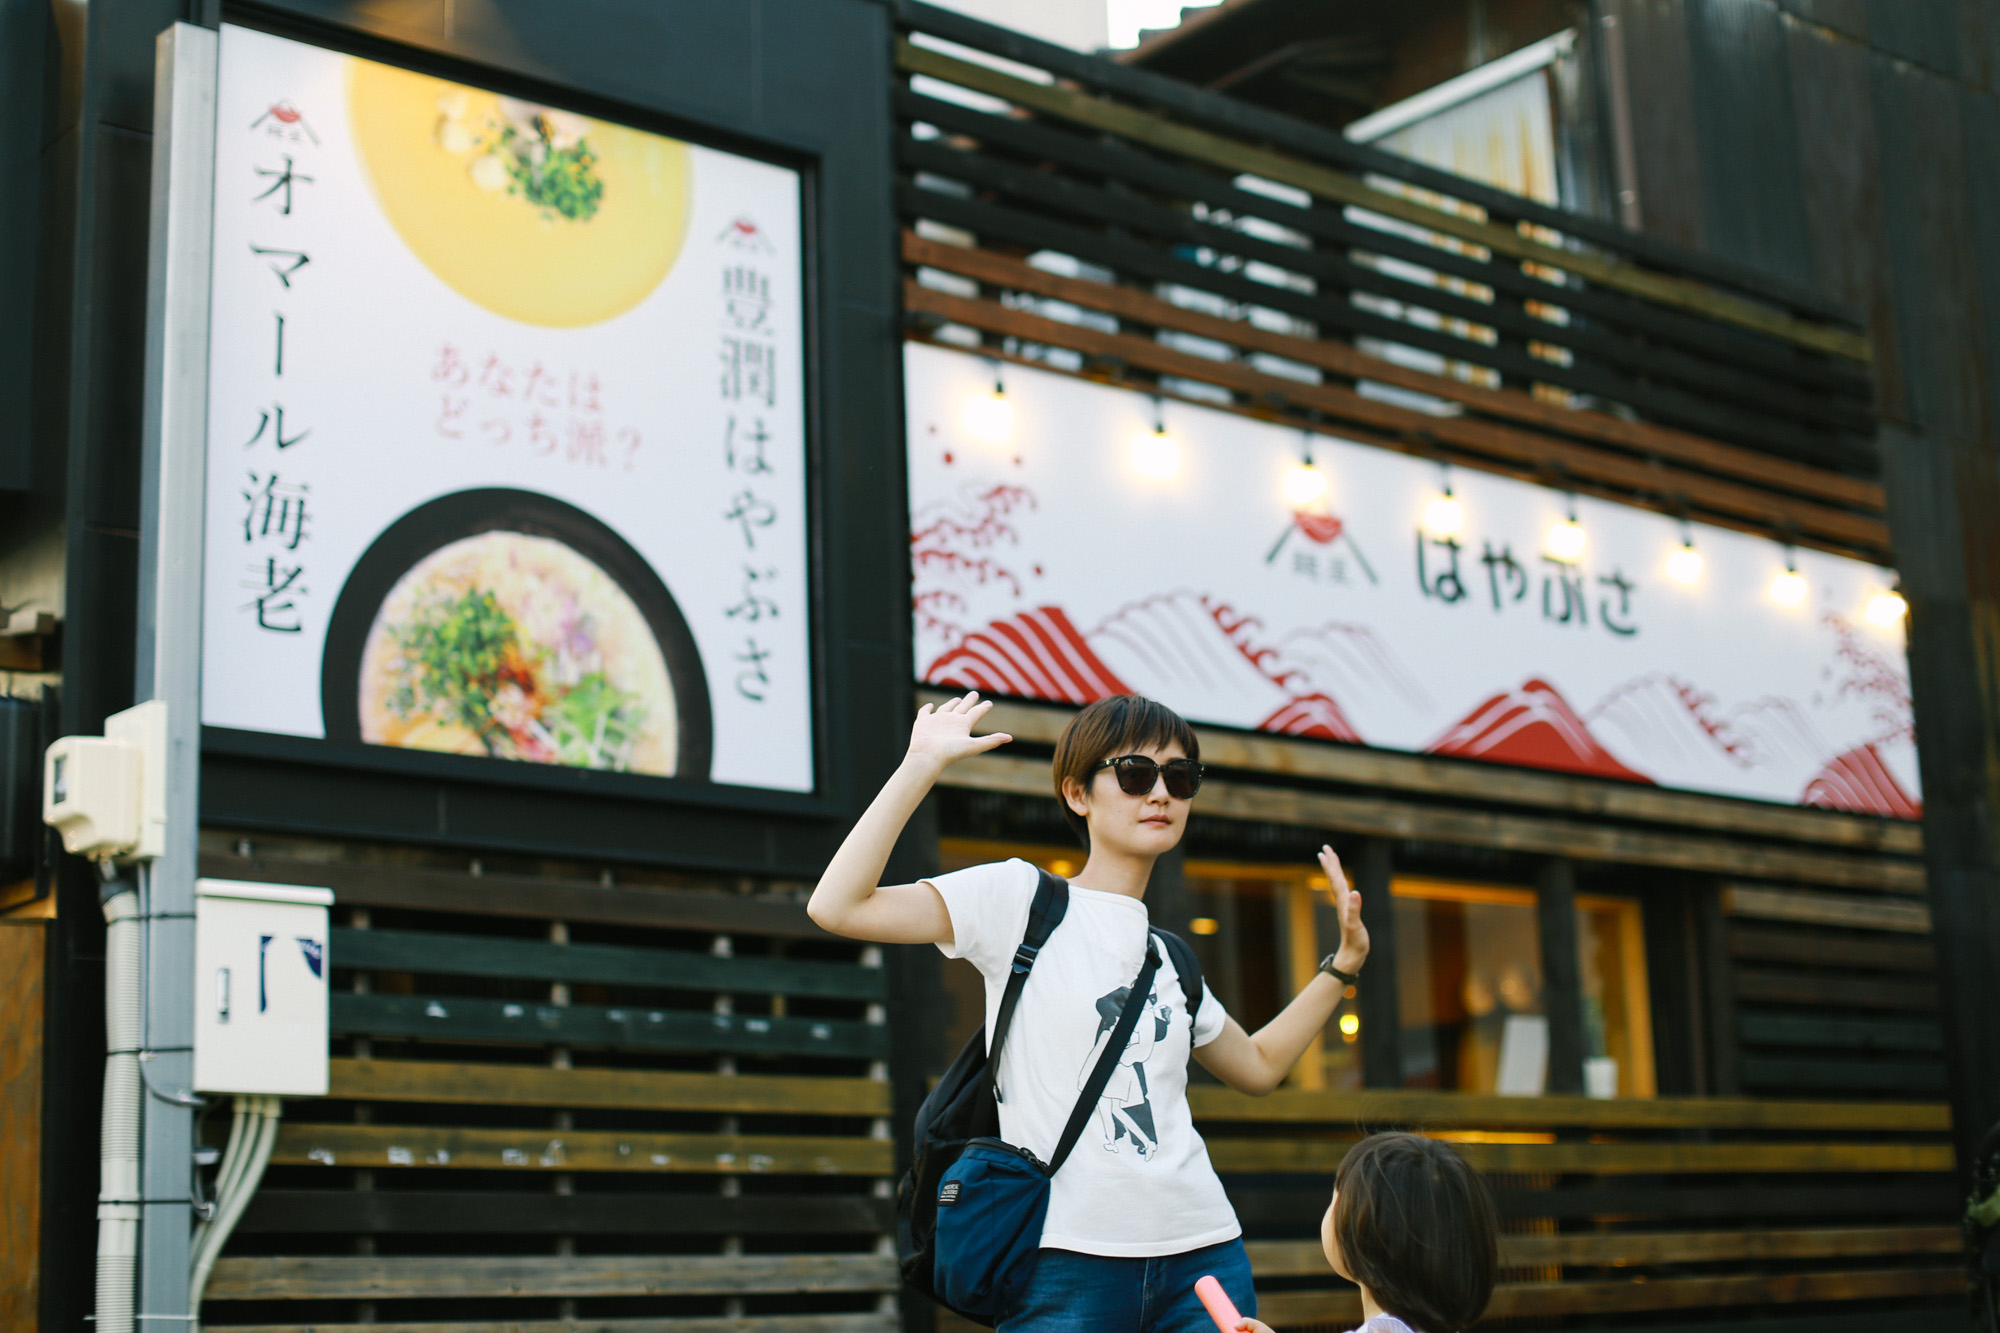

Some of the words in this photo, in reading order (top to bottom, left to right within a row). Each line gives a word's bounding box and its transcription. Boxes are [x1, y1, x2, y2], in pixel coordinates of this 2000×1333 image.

[240, 156, 314, 634] オマール海老
[431, 341, 604, 412] あなたは
[719, 266, 780, 703] 豊潤はやぶさ
